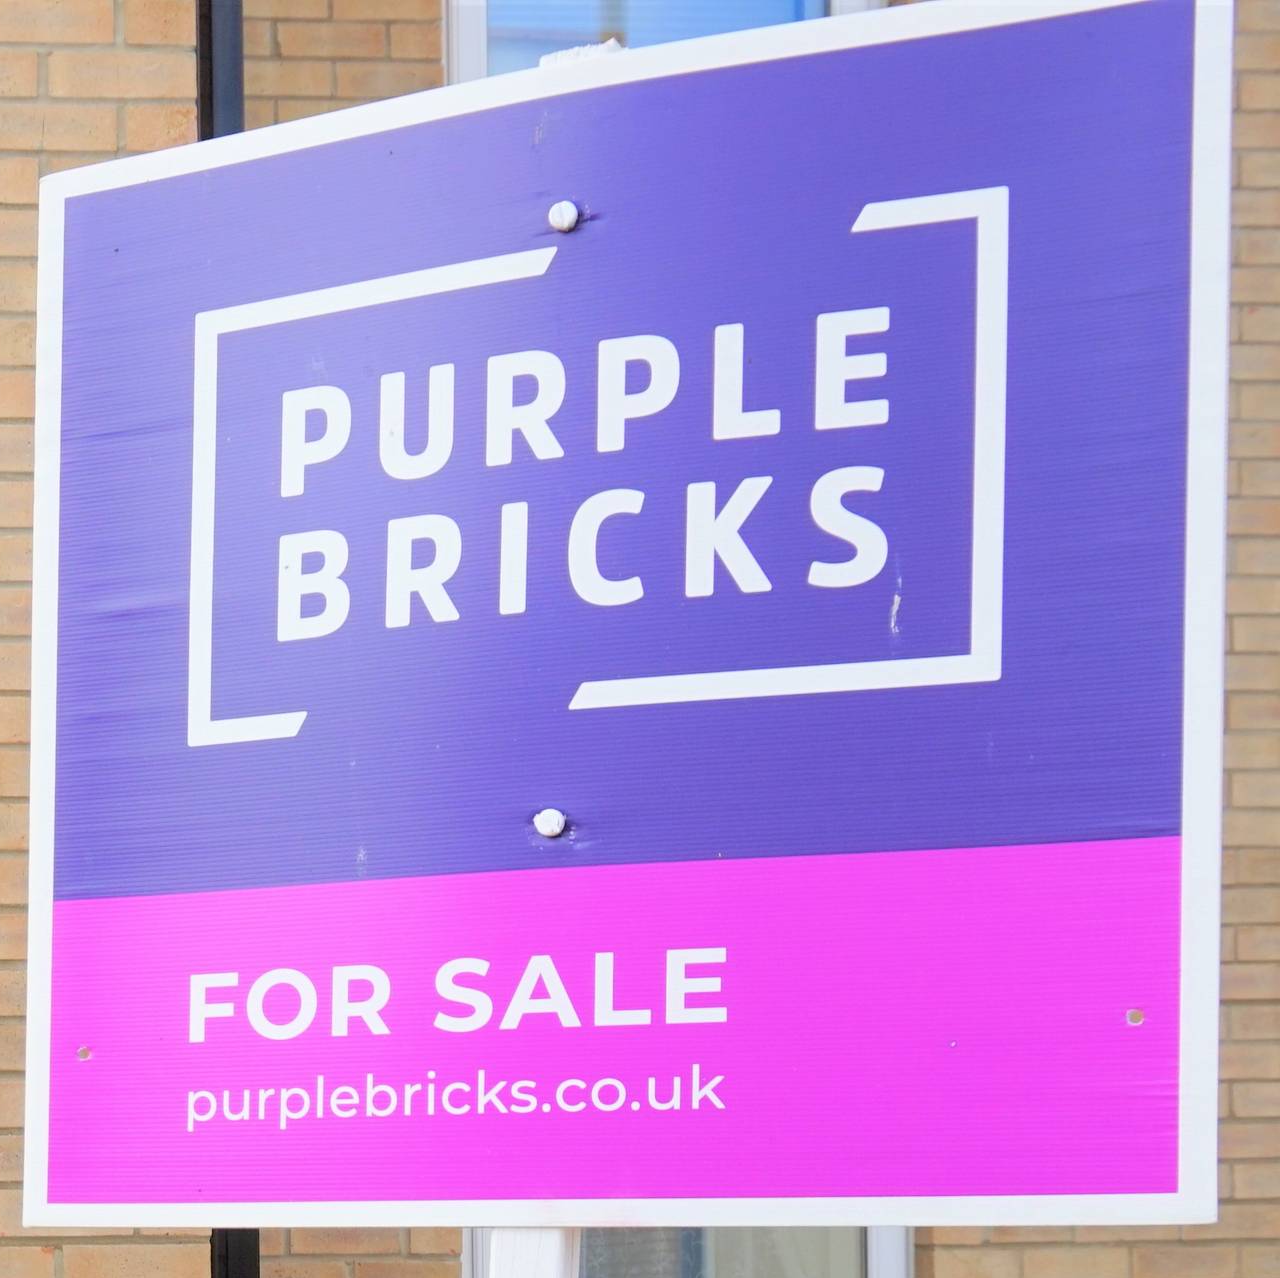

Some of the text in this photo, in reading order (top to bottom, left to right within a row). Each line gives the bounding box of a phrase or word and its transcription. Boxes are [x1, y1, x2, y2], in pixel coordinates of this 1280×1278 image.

[279, 306, 891, 498] PURPLE
[276, 465, 890, 642] BRICKS
[188, 947, 728, 1043] FOR SALE
[186, 1064, 727, 1132] purplebricks.co.uk
